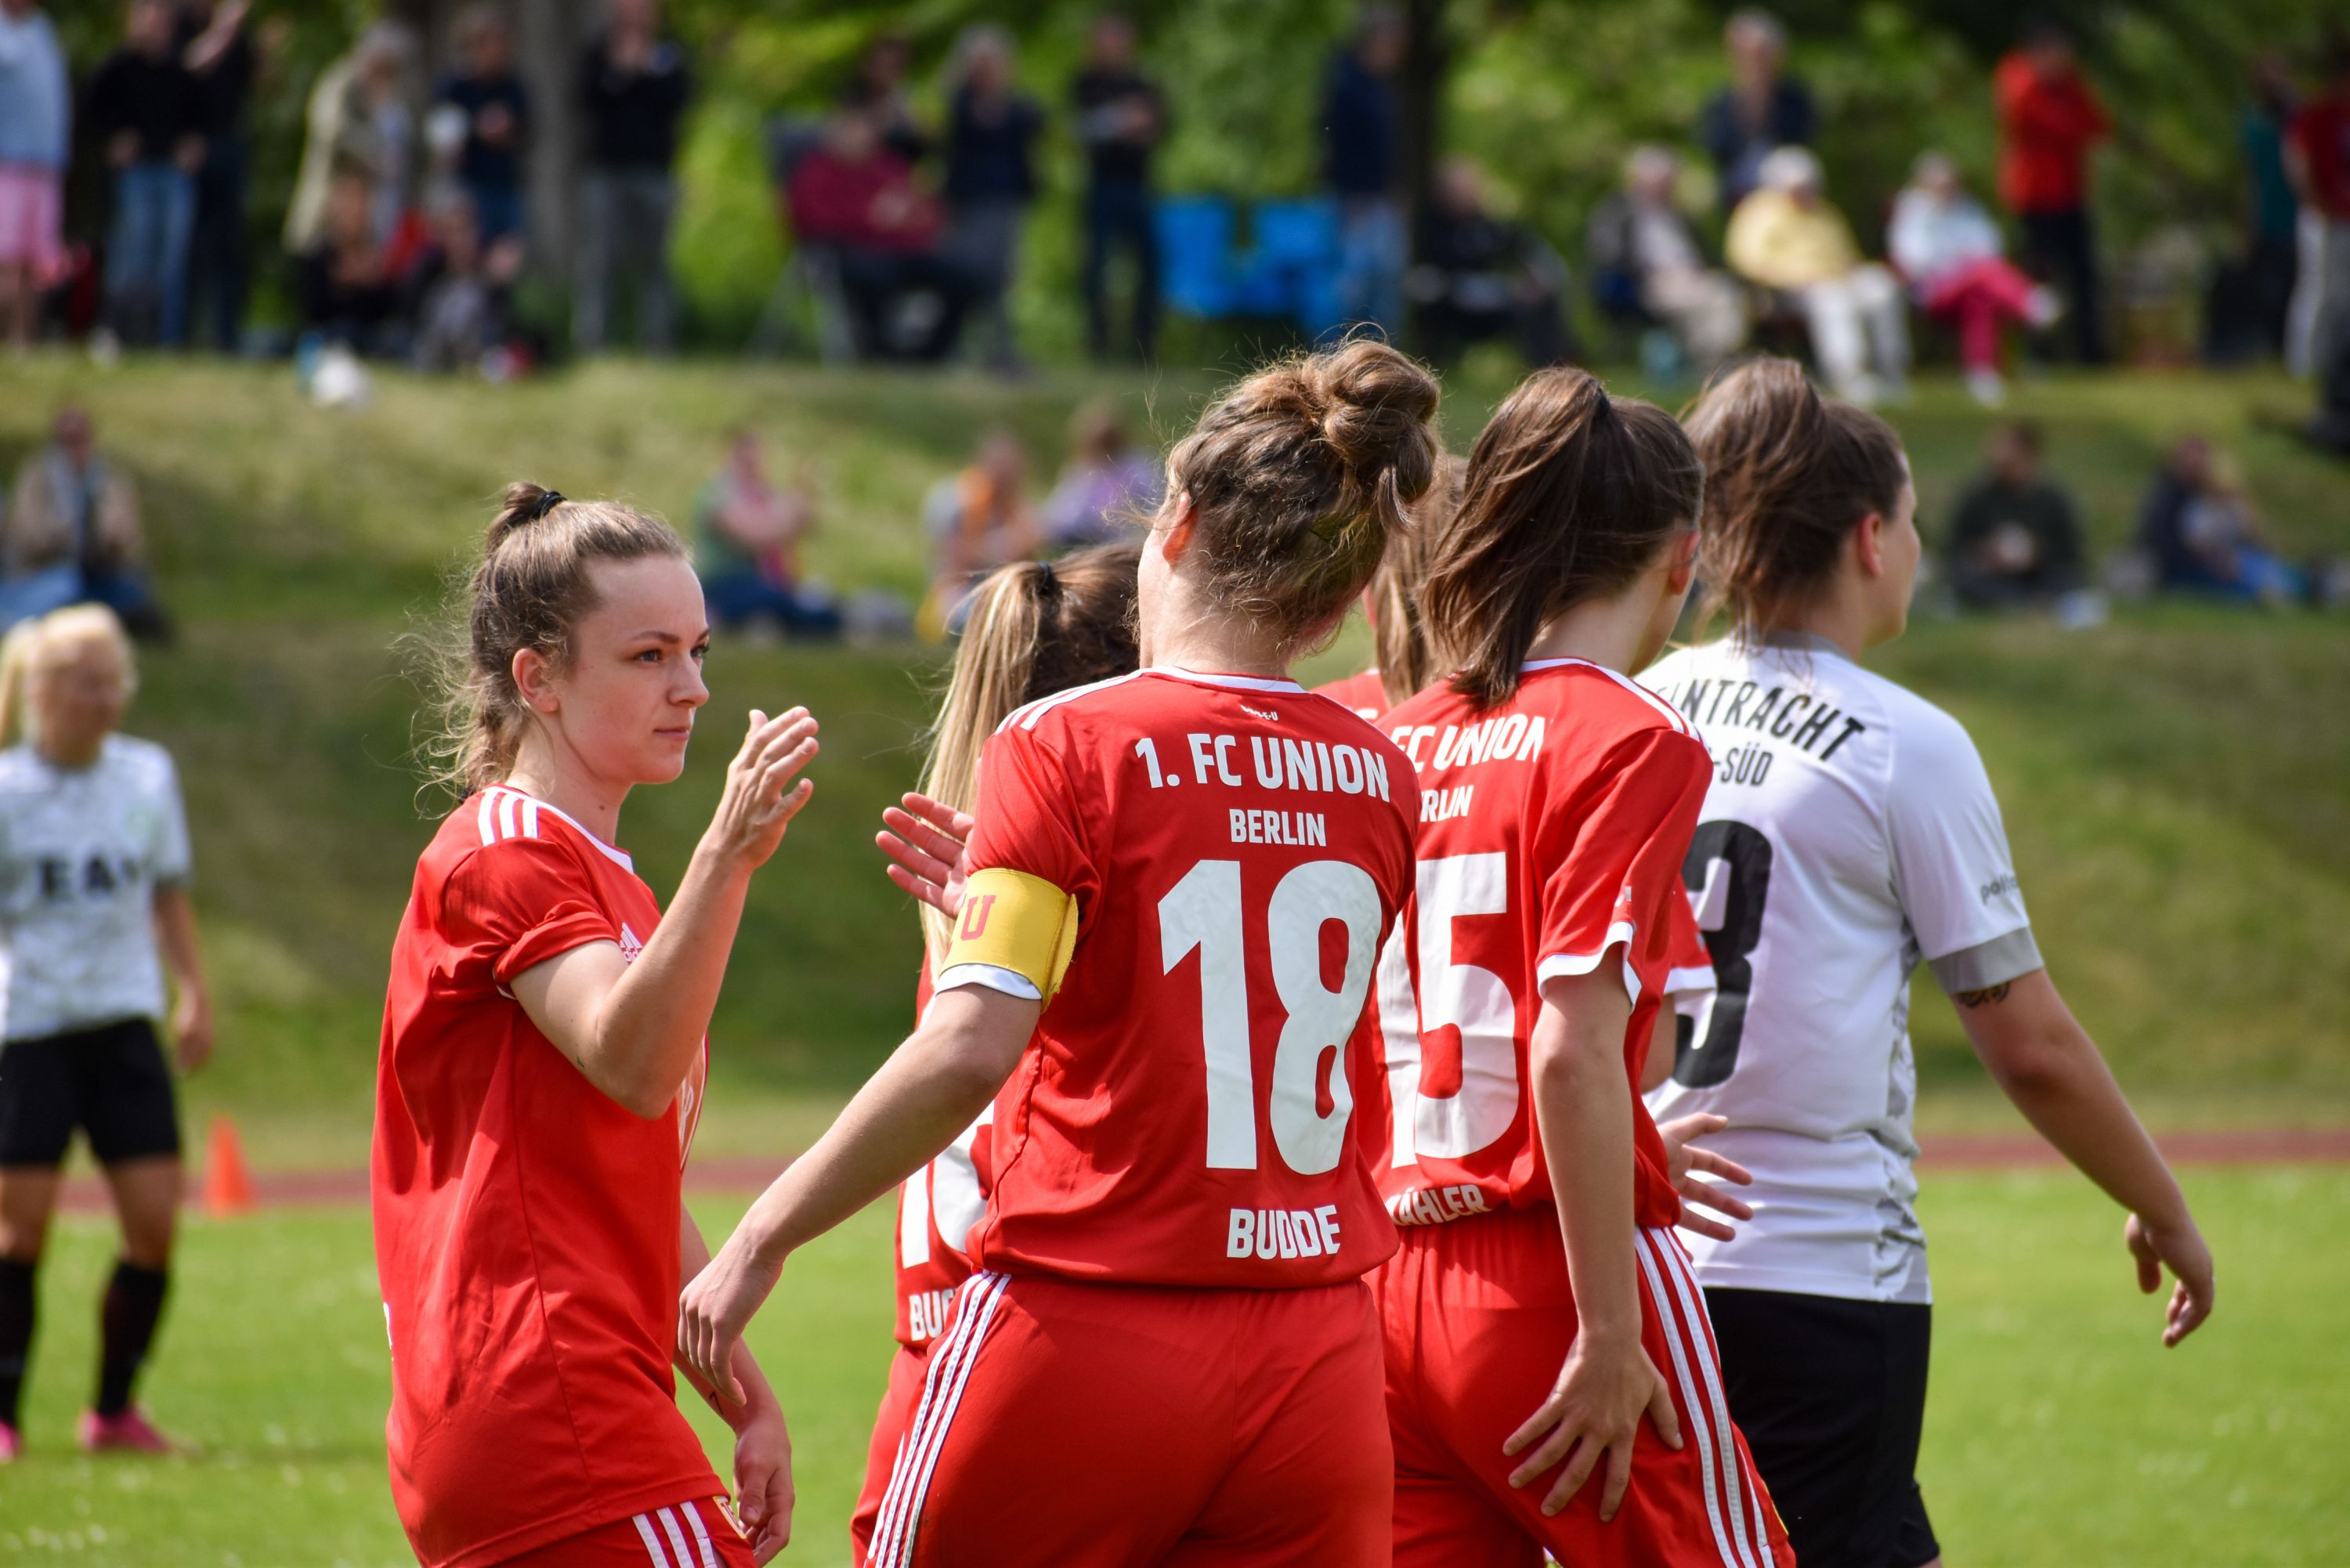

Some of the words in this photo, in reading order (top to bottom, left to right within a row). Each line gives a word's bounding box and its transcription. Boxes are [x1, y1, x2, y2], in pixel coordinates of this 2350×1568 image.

[1134, 737, 1180, 789] 1.
[1187, 733, 1242, 787] FC
[1251, 736, 1391, 803] UNION
[1229, 808, 1327, 847] BERLIN
[1158, 859, 1383, 1176] 18
[1376, 851, 1519, 1169] 15
[1227, 1205, 1341, 1259] BUDDE
